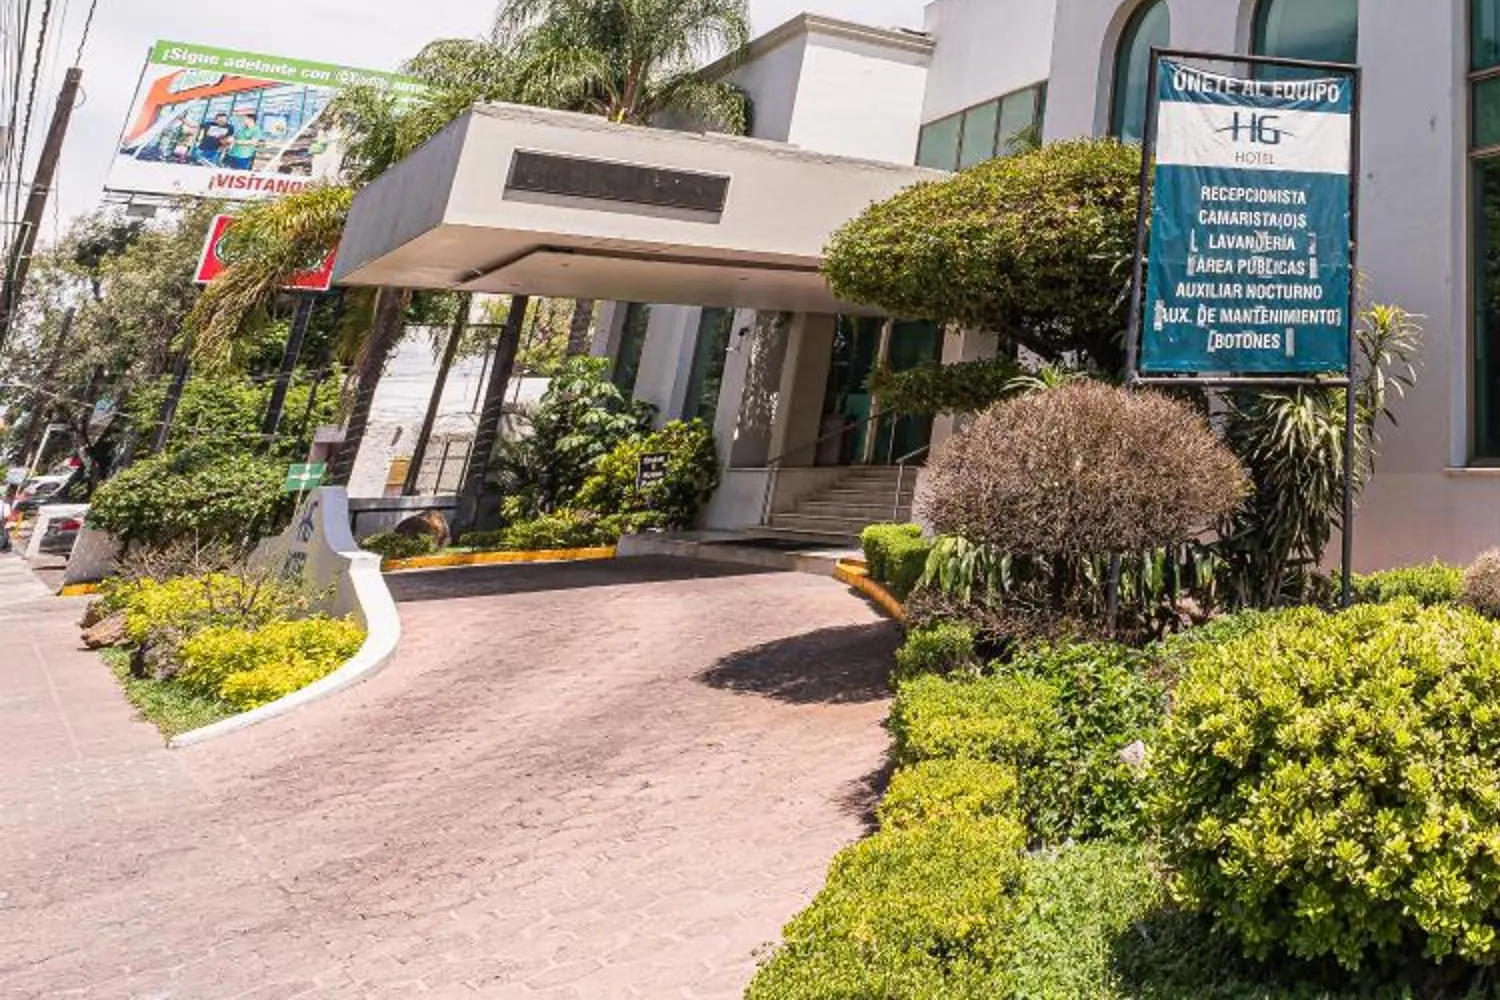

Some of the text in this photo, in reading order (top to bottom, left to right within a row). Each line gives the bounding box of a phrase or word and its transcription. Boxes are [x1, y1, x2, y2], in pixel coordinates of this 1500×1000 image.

[1241, 79, 1266, 98] AL
[1272, 80, 1341, 104] EQUIPO
[1215, 111, 1295, 145] HG
[1235, 151, 1276, 165] HOTEL
[1201, 185, 1307, 205] RECEPCIONISTA
[1199, 209, 1308, 229] CAMARISTA(O)S
[1175, 282, 1323, 301] AUXILIAR NOCTURNO
[1198, 307, 1217, 324] DE
[1219, 307, 1336, 326] MANTENIMIENTO
[1214, 332, 1281, 350] BOTONES
